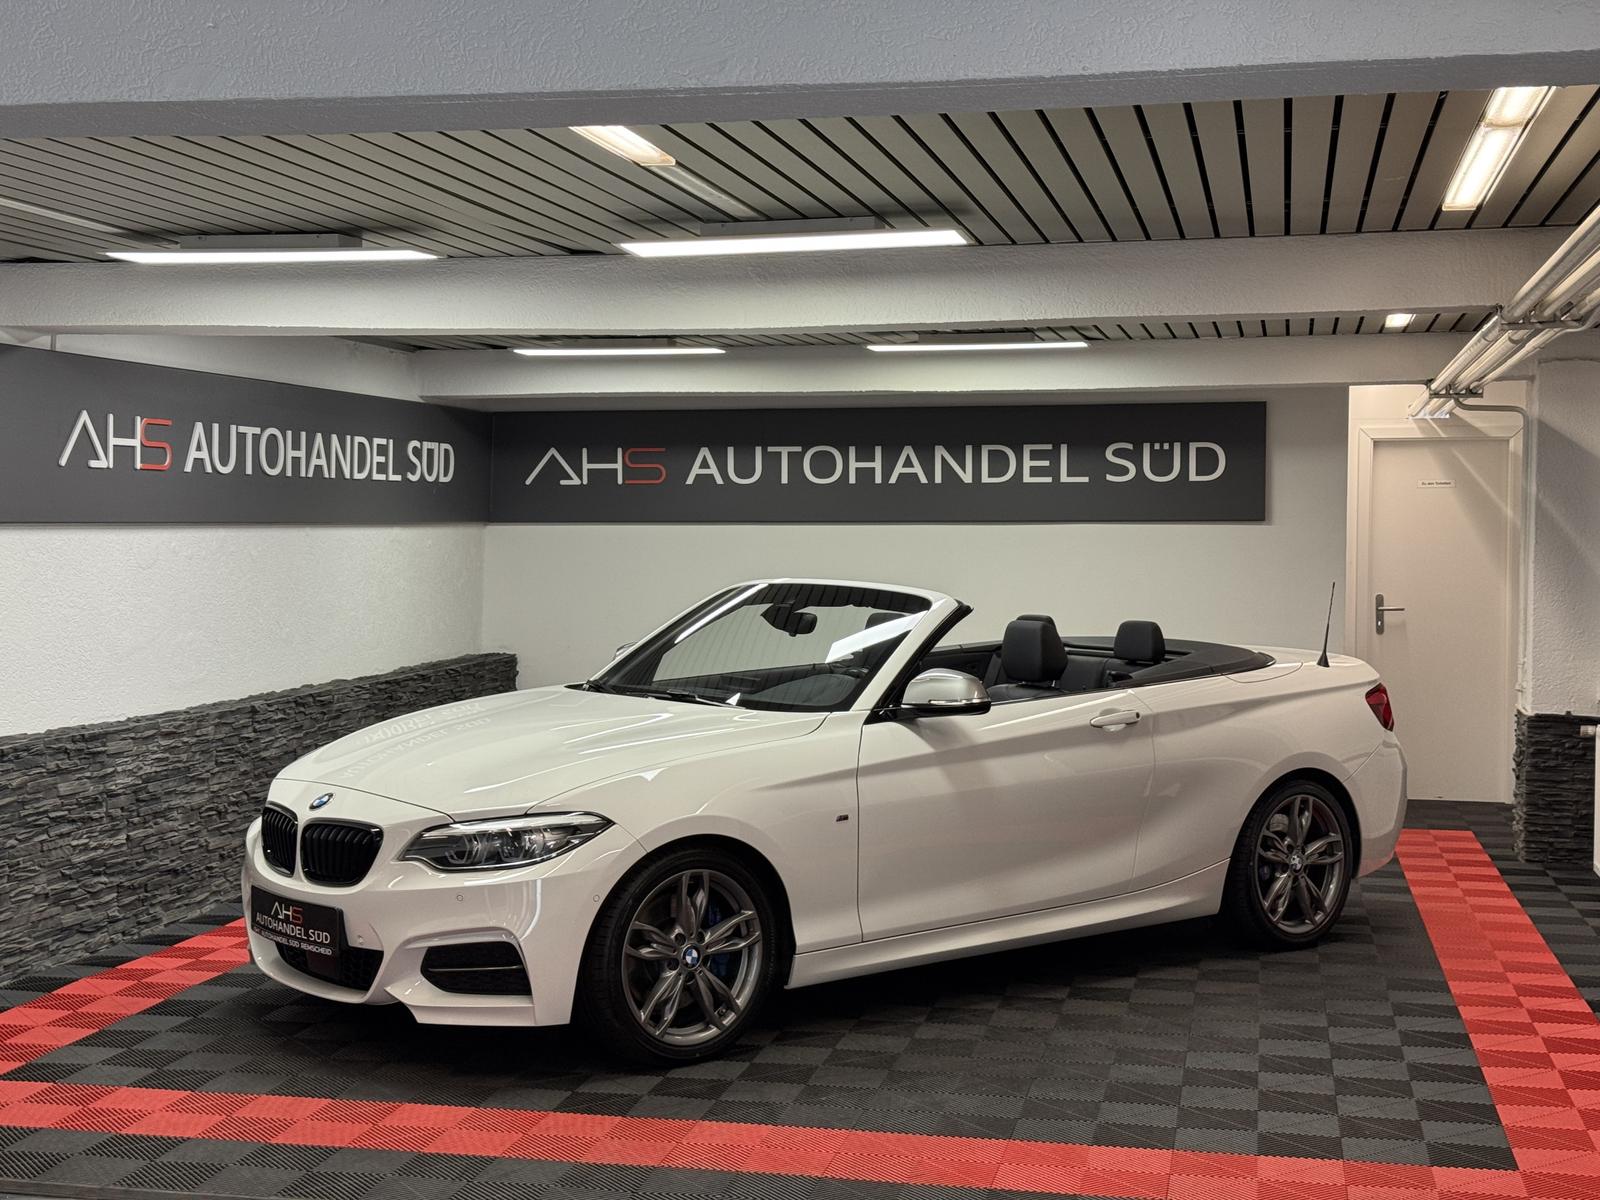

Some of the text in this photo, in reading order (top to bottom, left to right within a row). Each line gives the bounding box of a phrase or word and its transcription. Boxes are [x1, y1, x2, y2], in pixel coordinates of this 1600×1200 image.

[59, 410, 455, 482] AHS AUTOHANDEL SÜD
[525, 442, 1226, 486] AHS AUTOHANDEL SÜD
[256, 912, 330, 944] AUTOHANDEL SÜD
[271, 901, 303, 924] AHS
